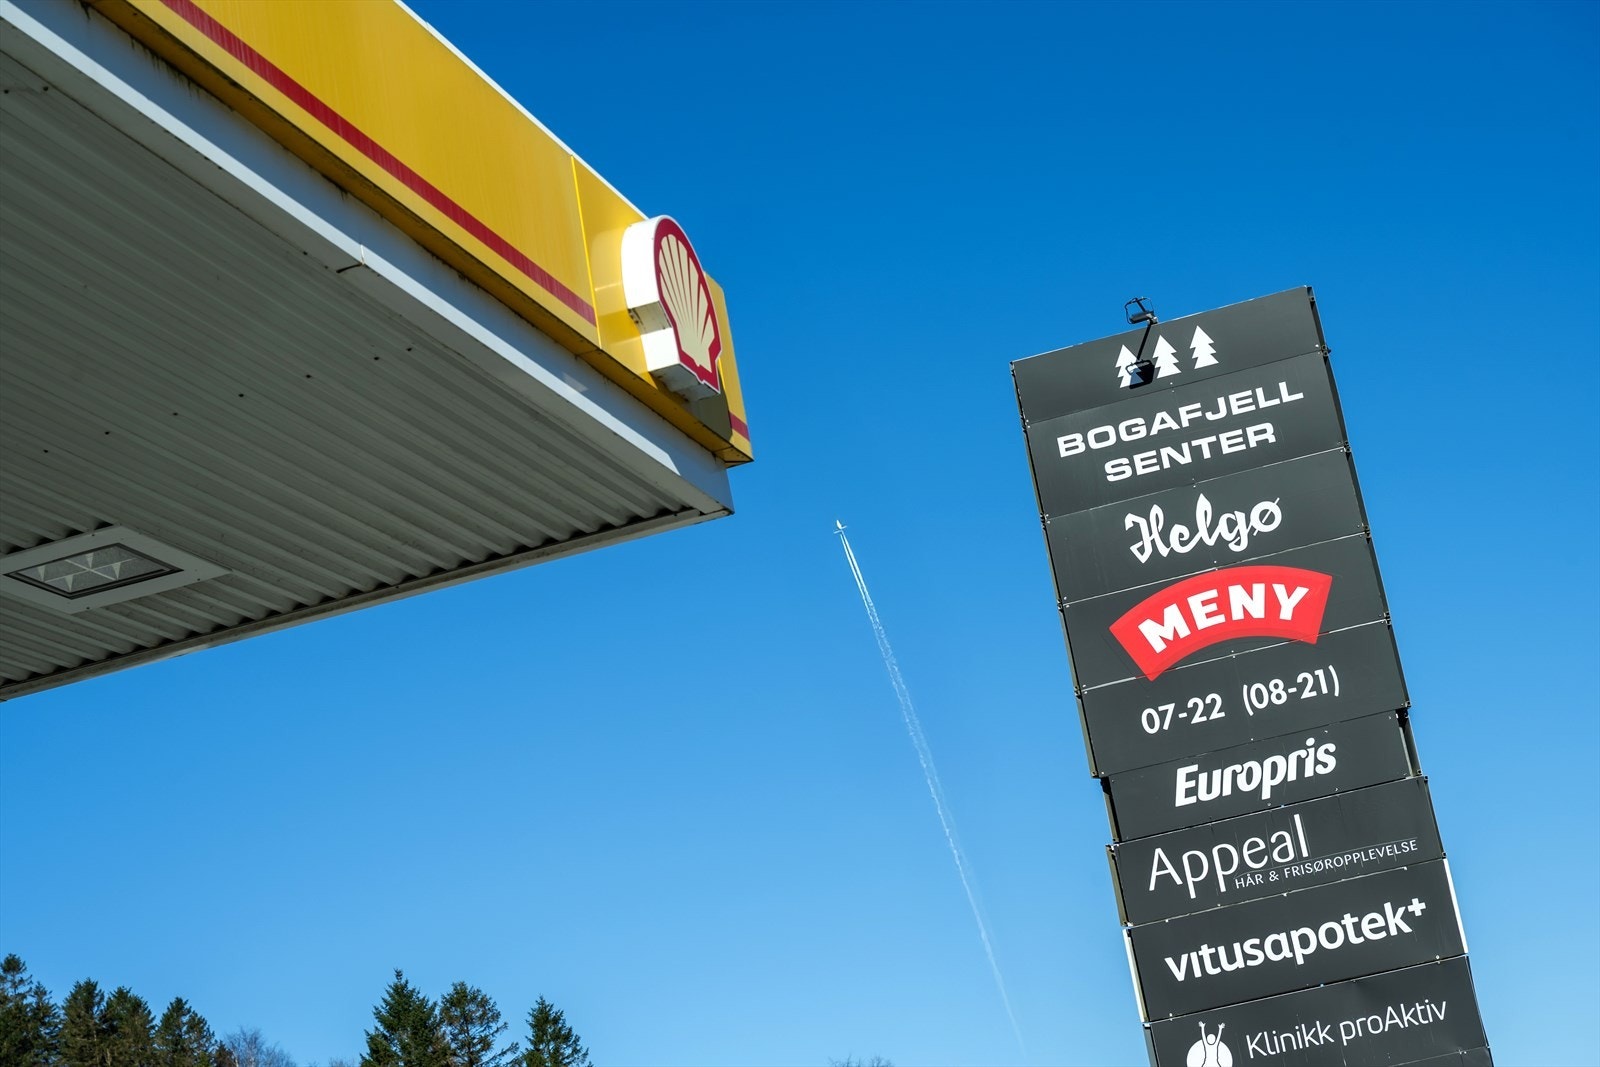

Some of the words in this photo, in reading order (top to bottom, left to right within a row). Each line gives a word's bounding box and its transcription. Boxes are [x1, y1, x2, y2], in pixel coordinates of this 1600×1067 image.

[1056, 381, 1304, 458] BOGAFJELL
[1104, 421, 1277, 482] SENTER
[1124, 493, 1283, 564] Helgø
[1137, 582, 1310, 654] MENY
[1140, 692, 1225, 735] 07-22
[1242, 664, 1340, 716] (08-21)
[1174, 737, 1337, 807] Europris
[1148, 814, 1309, 899] Appeal
[1235, 873, 1264, 889] HÅR
[1268, 871, 1280, 882] &
[1284, 839, 1418, 878] FRISØROPPLEVELSE
[1246, 1021, 1335, 1058] Klinikk
[1340, 999, 1447, 1046] proAktiv
